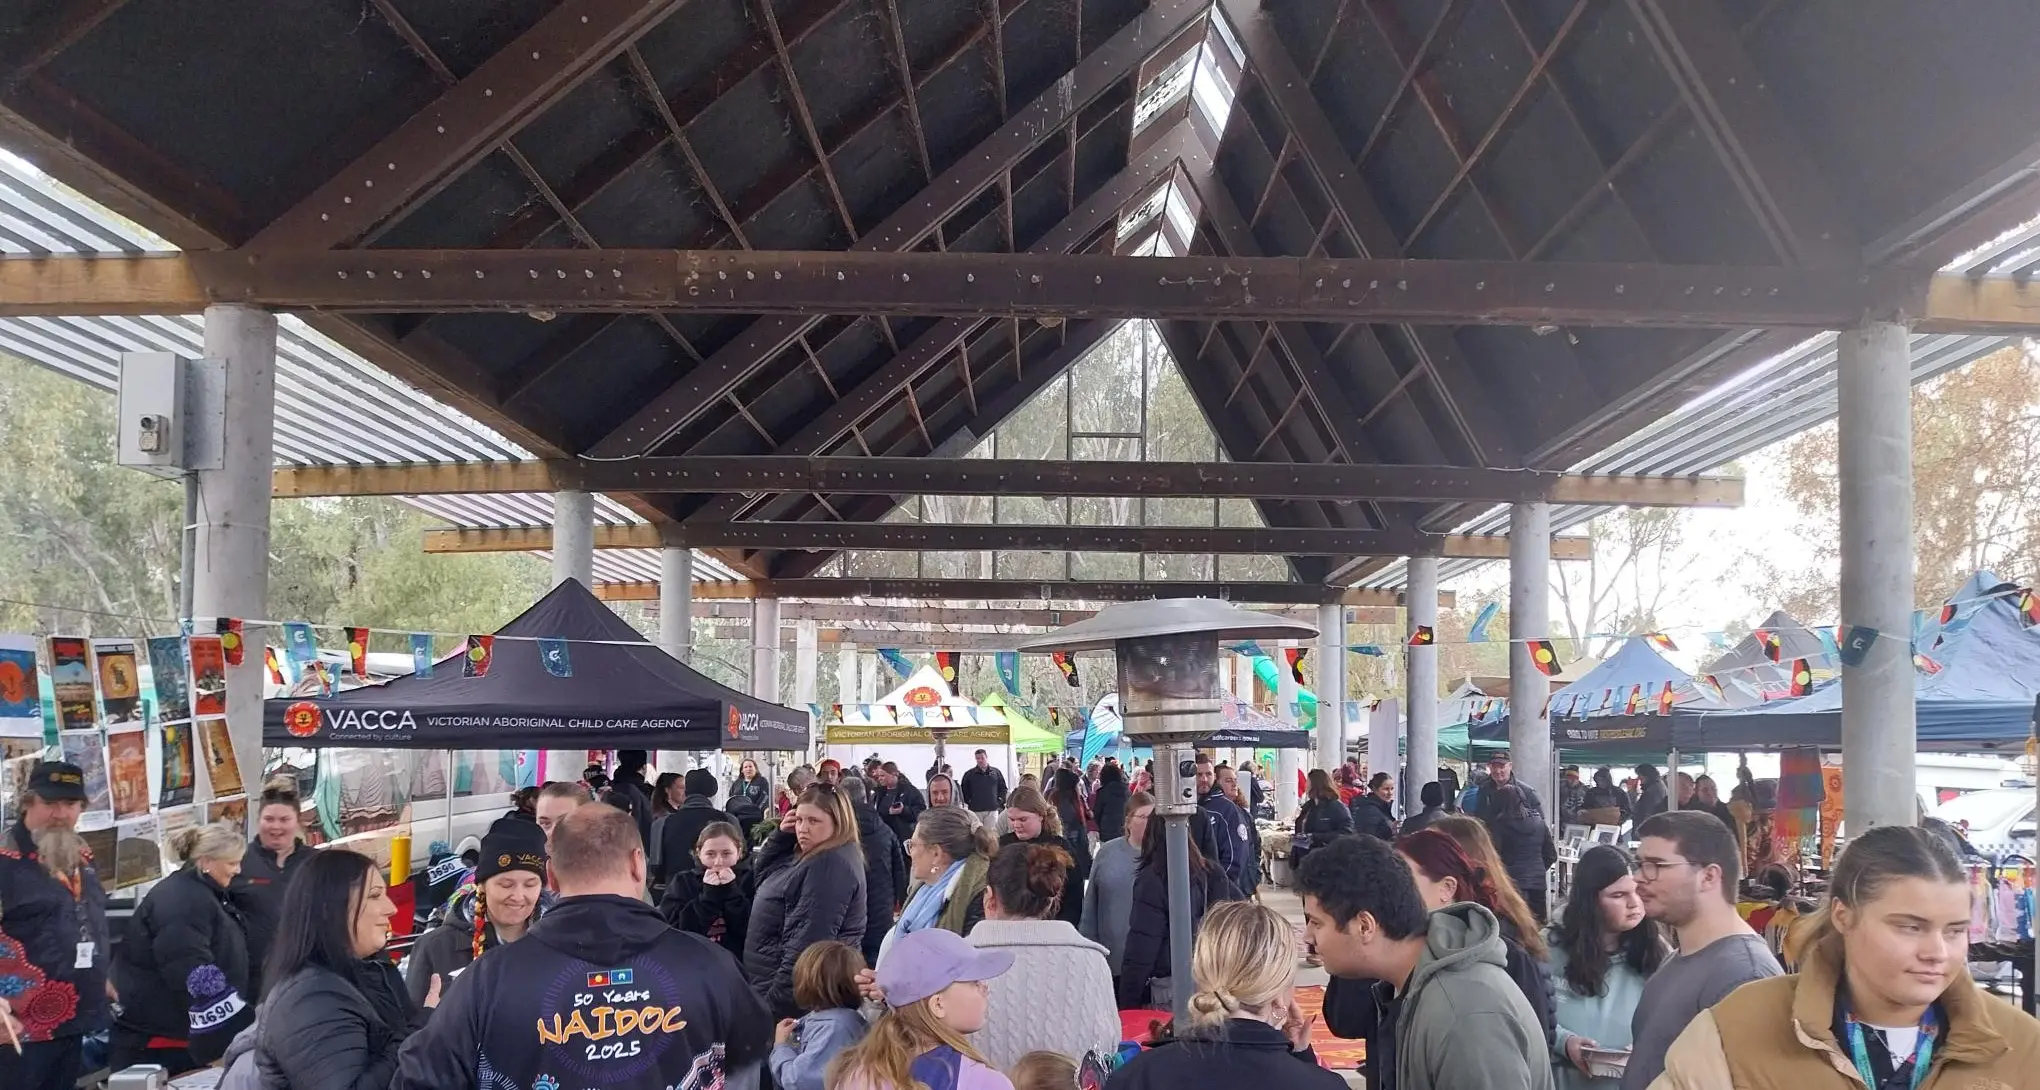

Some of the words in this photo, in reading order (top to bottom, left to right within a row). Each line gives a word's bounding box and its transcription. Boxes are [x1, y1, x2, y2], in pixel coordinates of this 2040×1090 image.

[326, 710, 417, 730] VACCA
[426, 716, 490, 727] VICTORIAN
[492, 716, 566, 728] ABORIGINAL
[568, 718, 604, 729] CHILD
[606, 718, 639, 729] CARE
[642, 718, 691, 729] AGENCY
[738, 713, 760, 731] VACCA
[328, 732, 372, 740] Connected
[373, 732, 382, 742] by
[384, 732, 412, 741] culture
[574, 993, 593, 1007] 50
[603, 989, 650, 1004] Years
[537, 1006, 688, 1045] NAIDOC
[585, 1040, 641, 1061] 2025
